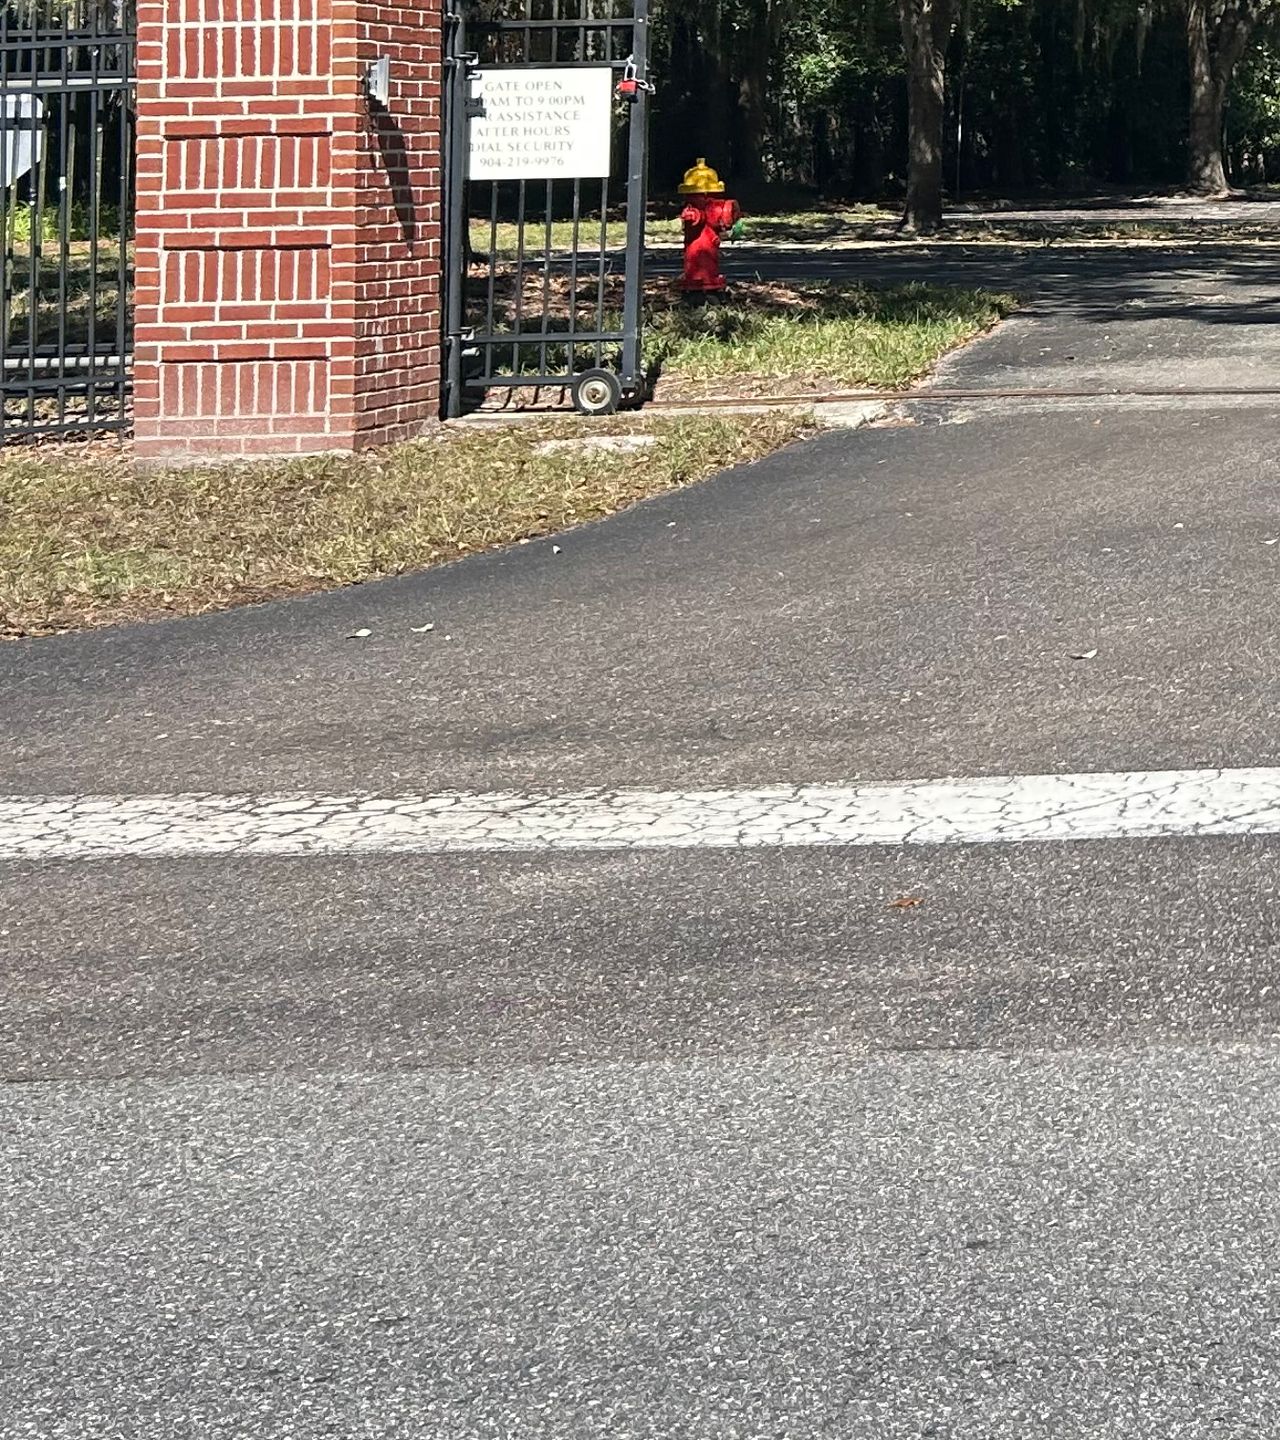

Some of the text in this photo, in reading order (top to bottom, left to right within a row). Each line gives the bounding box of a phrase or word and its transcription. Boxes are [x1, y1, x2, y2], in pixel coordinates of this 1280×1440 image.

[484, 80, 563, 92] GATE OPEN
[515, 96, 533, 106] TO
[496, 110, 581, 122] ASSISTANCE
[523, 125, 571, 137] HOURS
[507, 141, 575, 152] SECURITY
